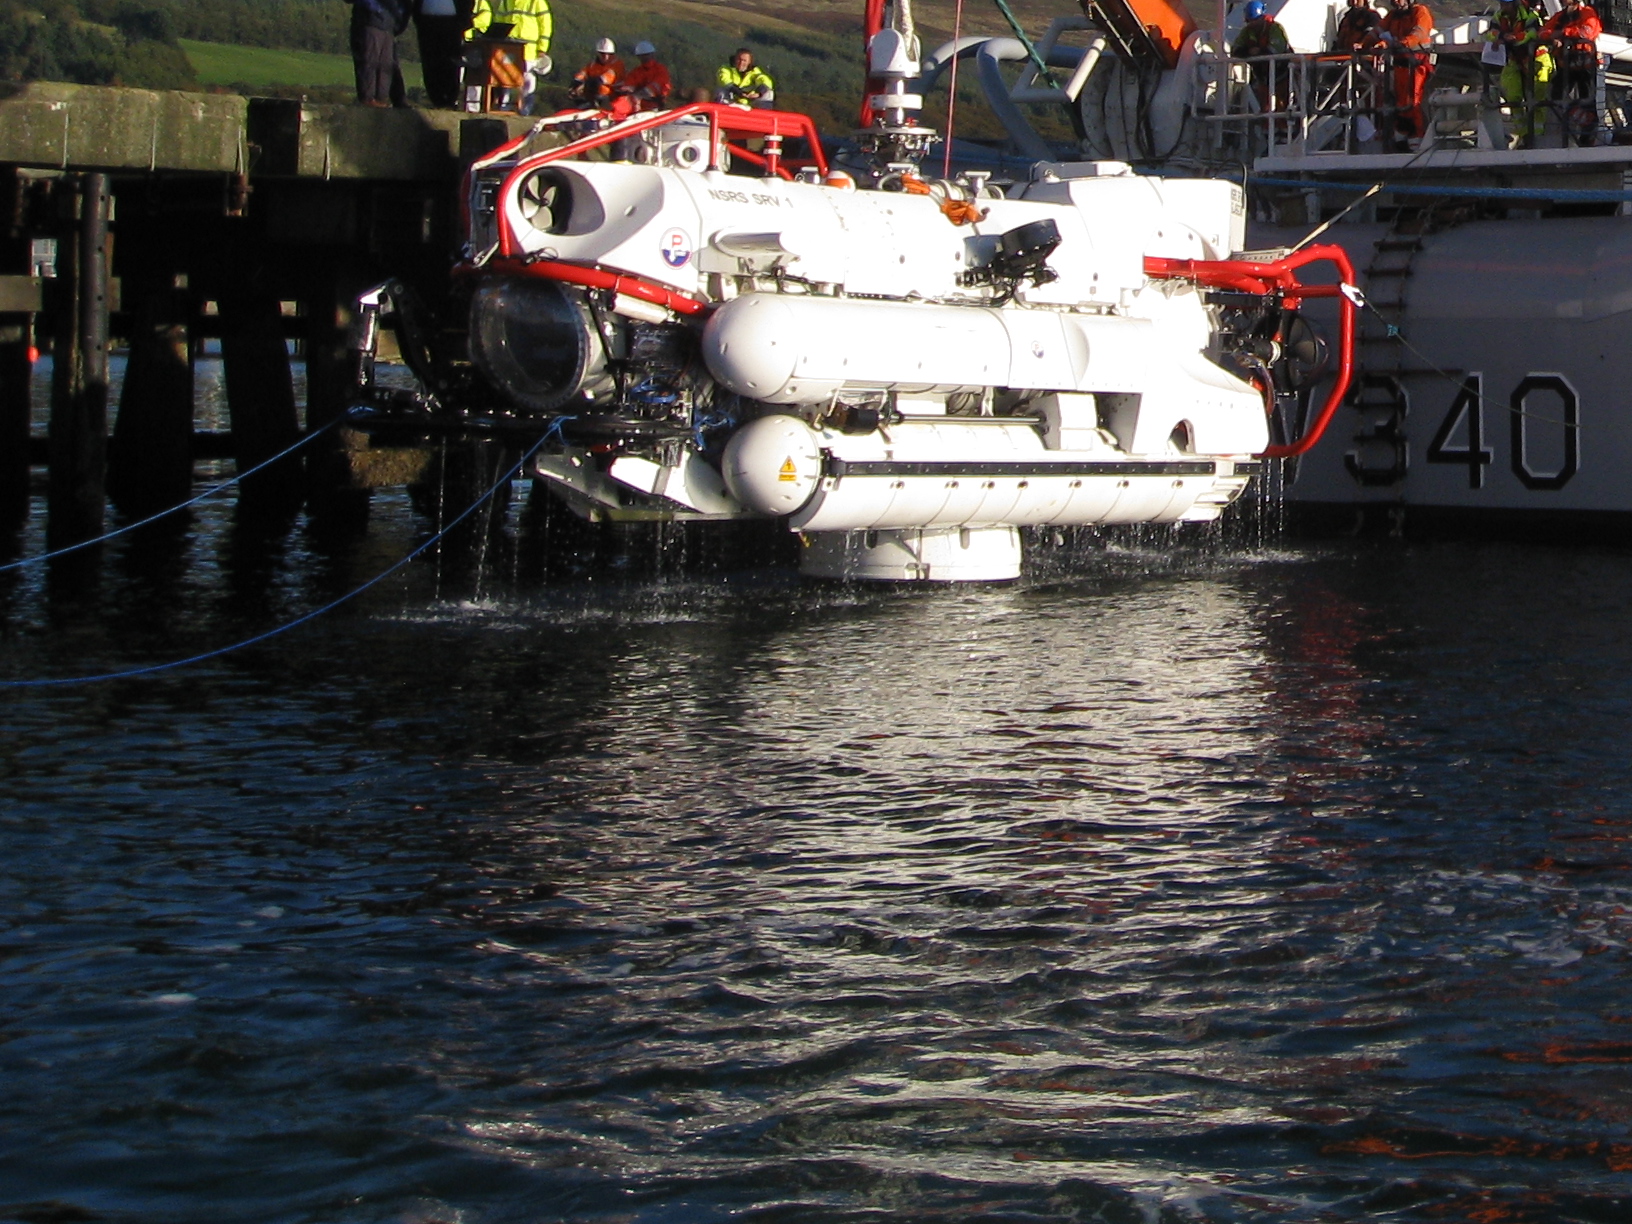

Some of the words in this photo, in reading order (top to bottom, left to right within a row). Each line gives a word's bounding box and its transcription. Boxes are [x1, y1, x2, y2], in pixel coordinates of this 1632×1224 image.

[707, 188, 750, 204] NSRS
[751, 192, 781, 207] SRV
[784, 196, 795, 209] 1
